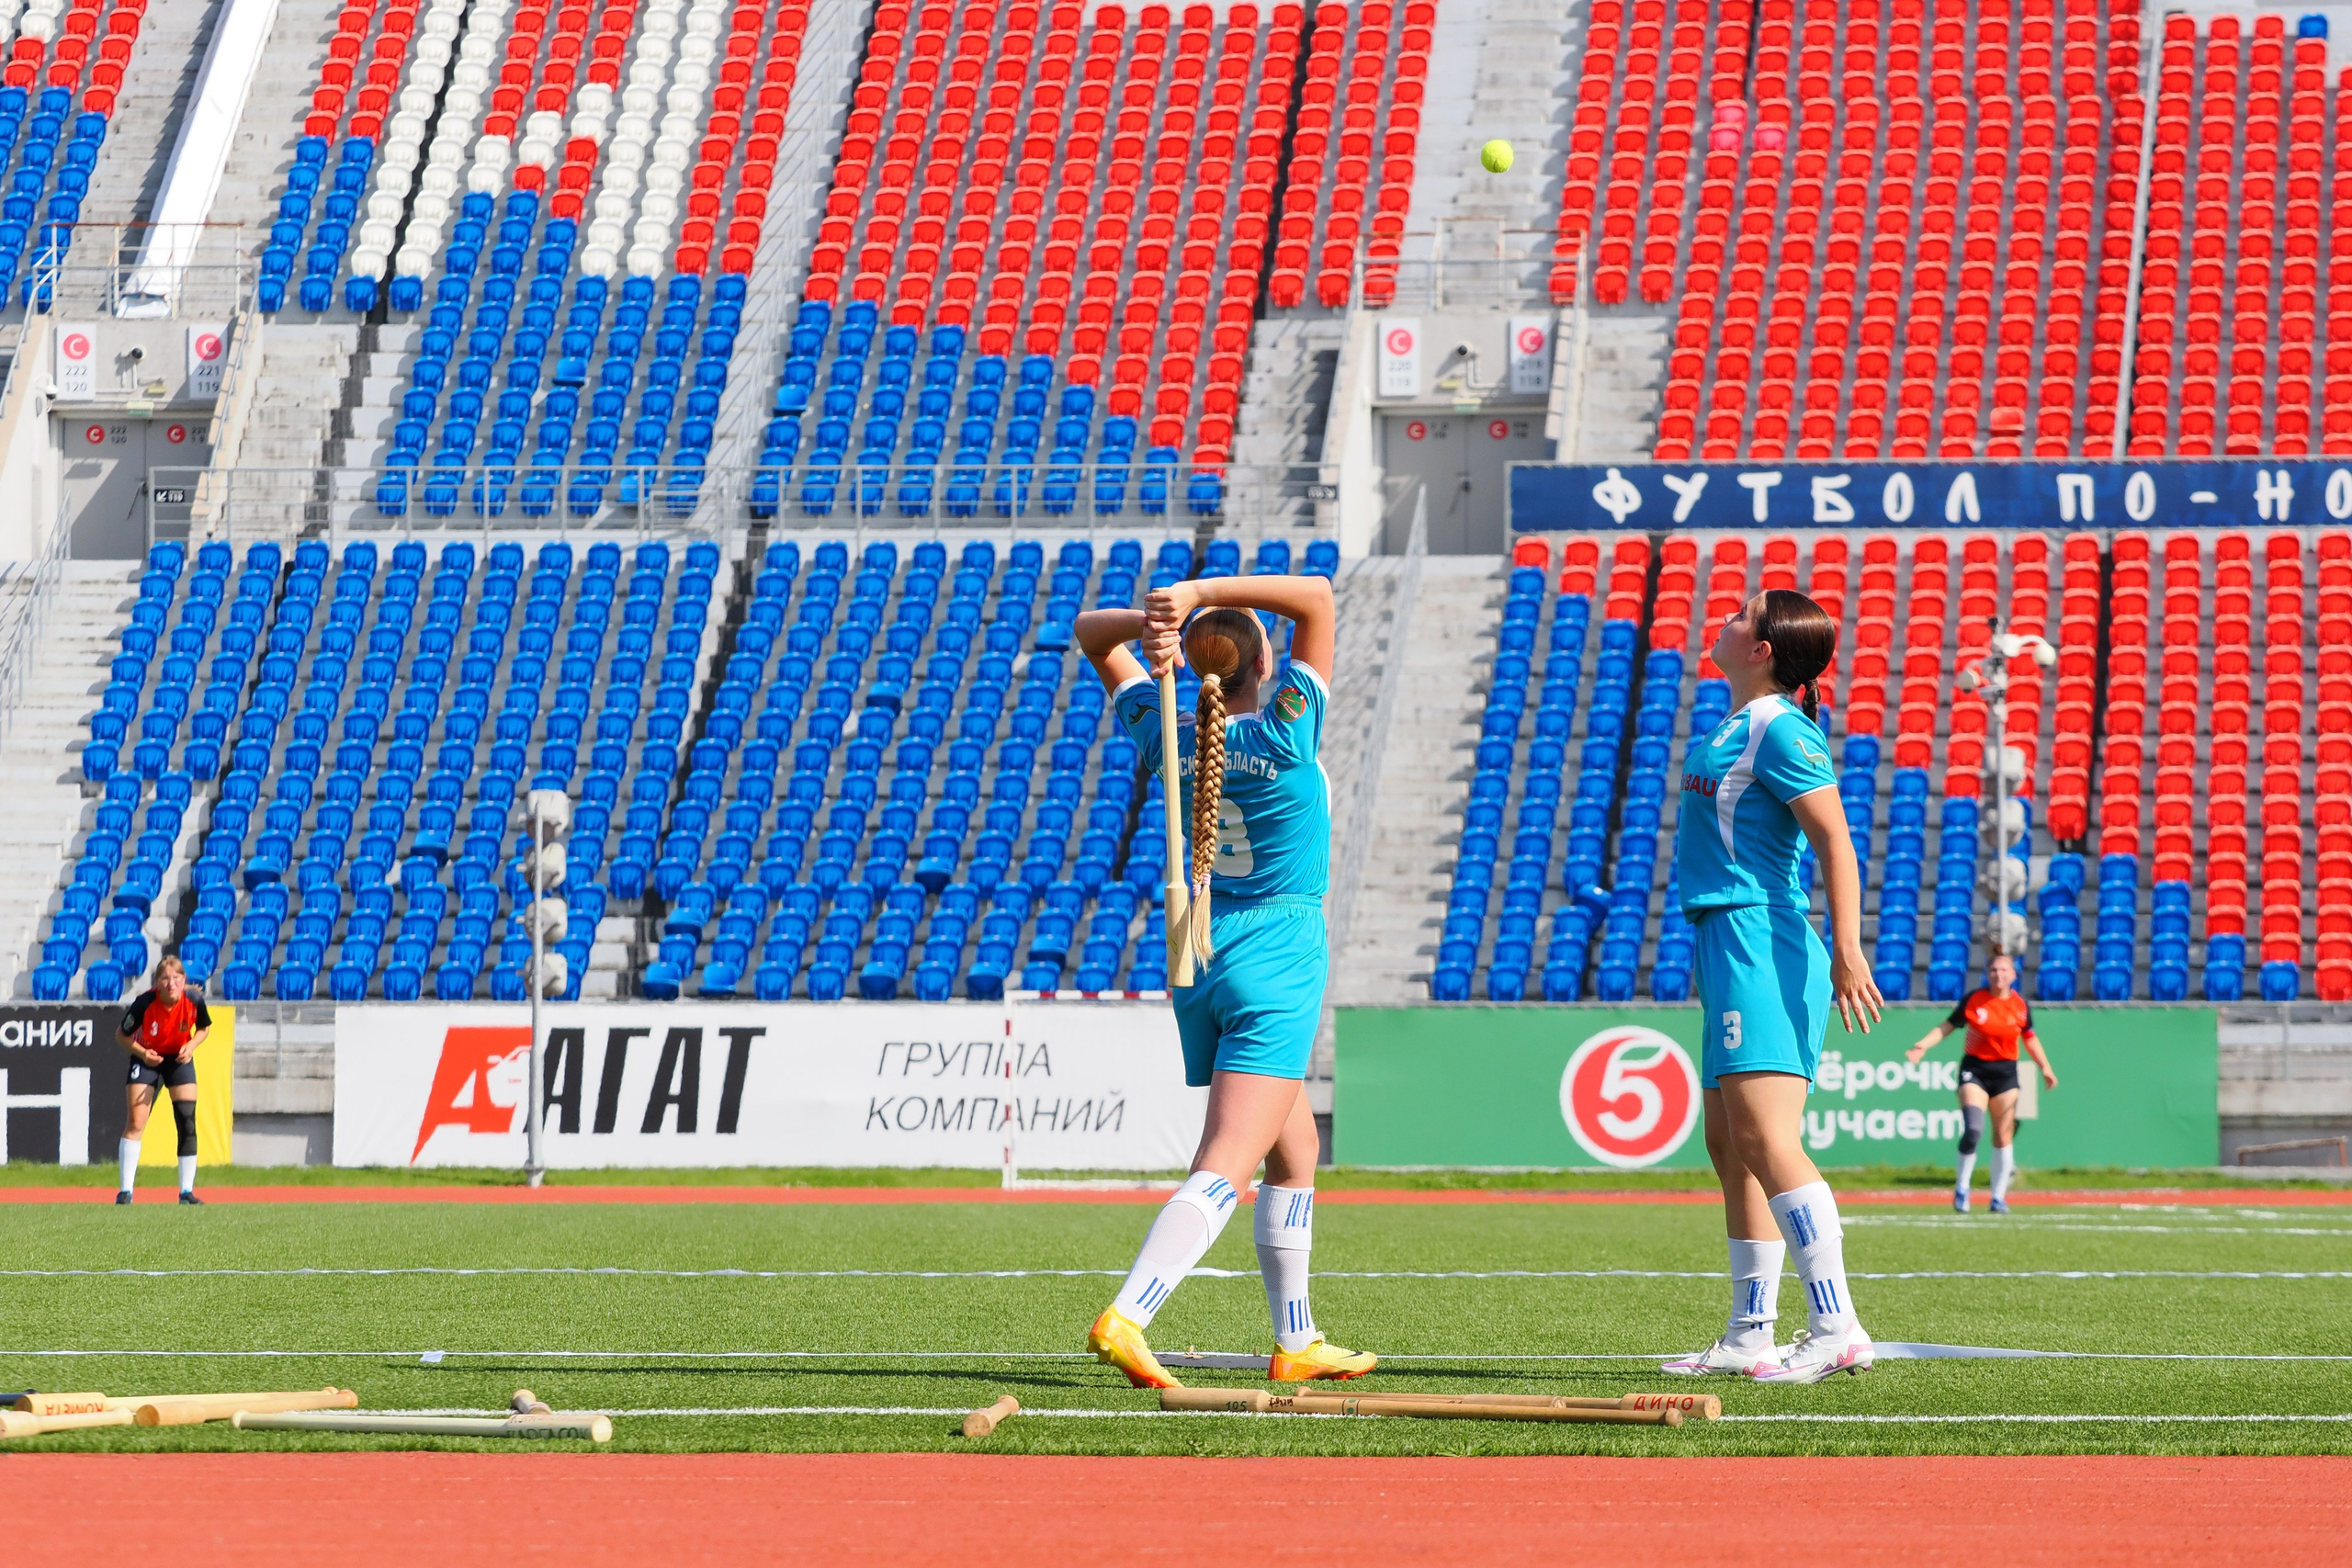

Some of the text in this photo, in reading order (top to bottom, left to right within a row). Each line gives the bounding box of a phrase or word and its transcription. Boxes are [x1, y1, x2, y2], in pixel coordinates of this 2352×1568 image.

[65, 366, 88, 377] 222
[198, 366, 220, 377] 221
[66, 381, 88, 393] 120
[198, 381, 220, 393] 119
[1592, 468, 1981, 524] ФУТБОЛ
[1712, 719, 1743, 747] 3
[1212, 798, 1254, 877] 8
[0, 1020, 93, 1048] ания
[150, 1021, 159, 1036] 3
[1723, 1010, 1742, 1050] 3
[877, 1043, 1052, 1077] ГРУППА
[523, 1027, 766, 1134] АГАТ
[1815, 1051, 1959, 1100] ёрочк
[865, 1089, 1126, 1133] КОМПАНИЙ
[1800, 1109, 1965, 1150] учает
[1226, 1401, 1247, 1411] 105
[1633, 1395, 1694, 1411] ДИНО
